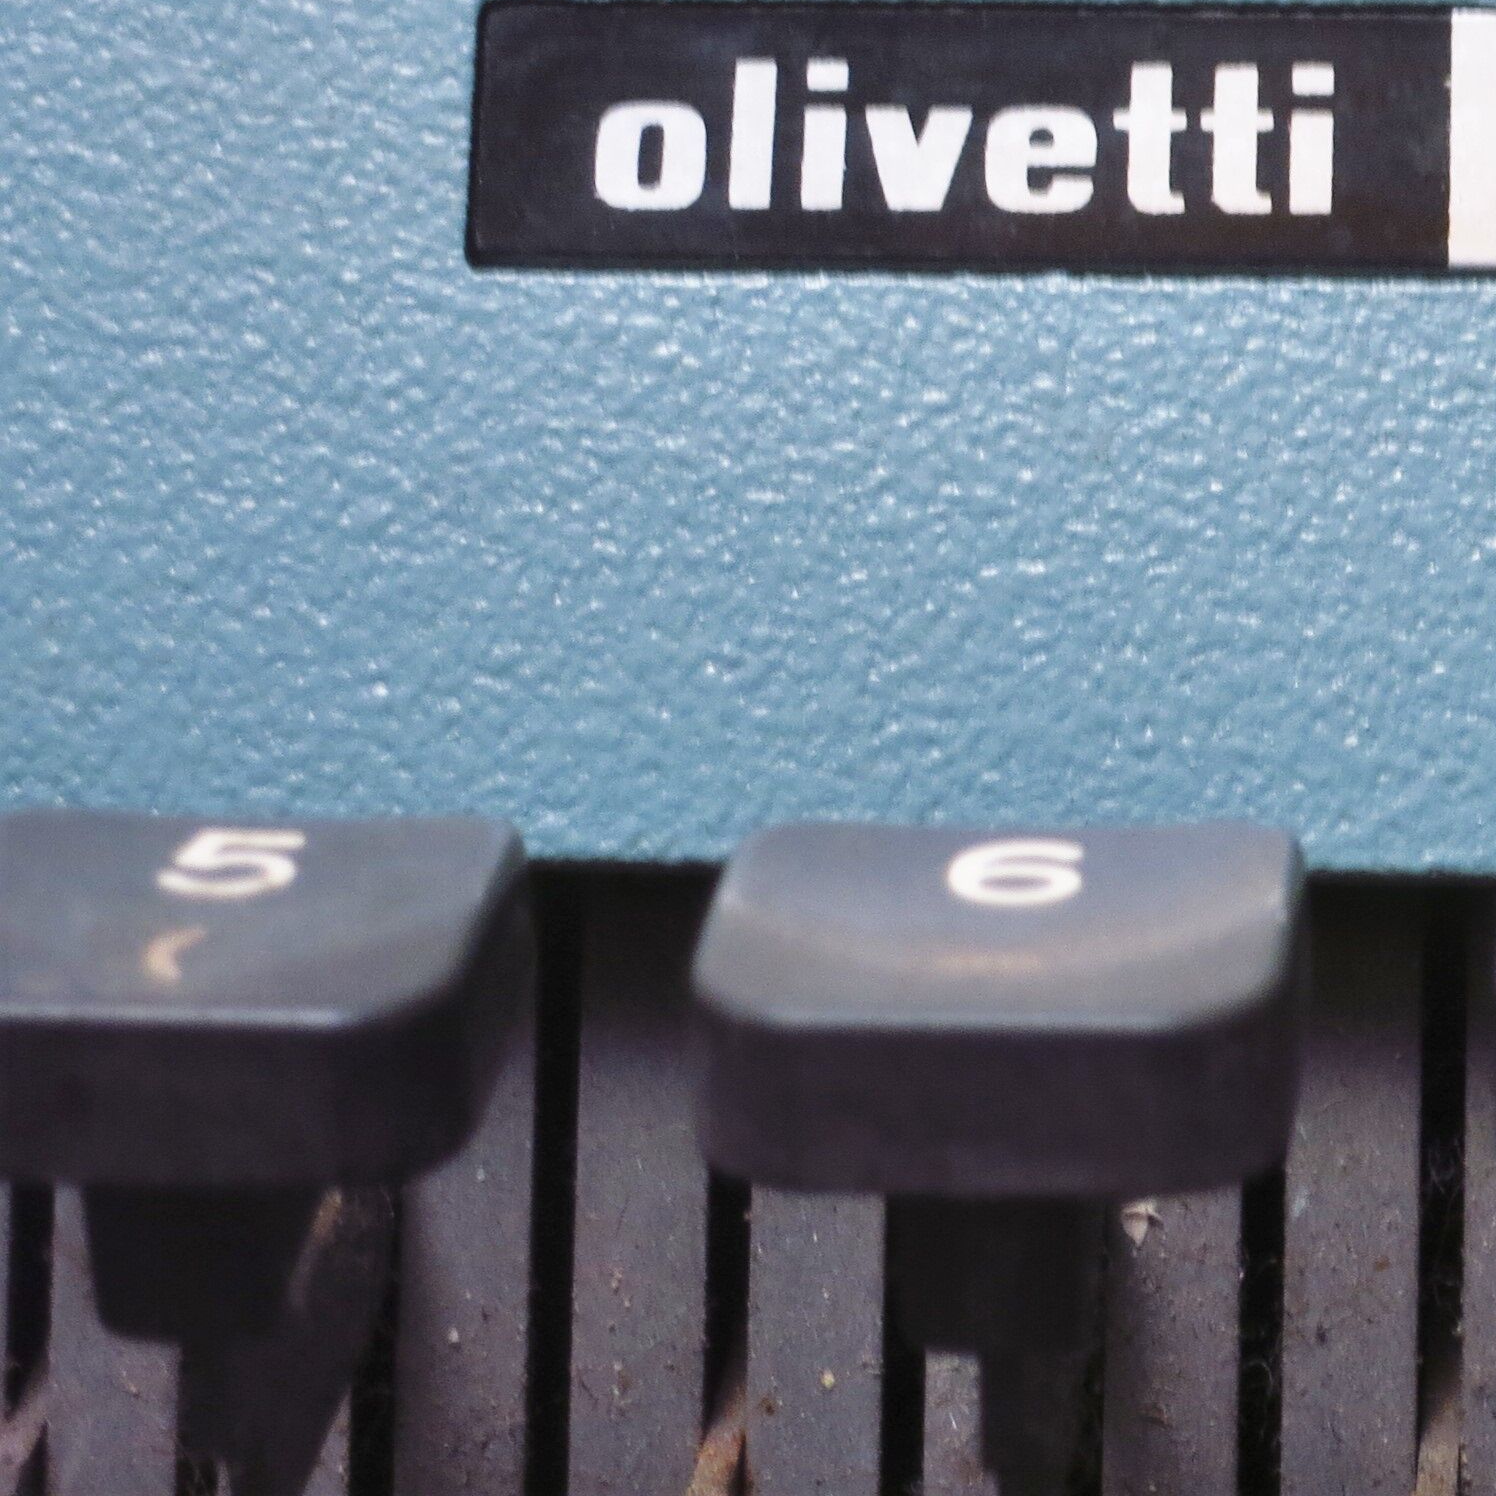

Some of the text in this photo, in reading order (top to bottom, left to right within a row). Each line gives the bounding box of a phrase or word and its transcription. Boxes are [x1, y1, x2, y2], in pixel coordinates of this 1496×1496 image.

[593, 57, 1336, 216] olivetti
[157, 828, 306, 899] 5
[946, 839, 1084, 907] 6
